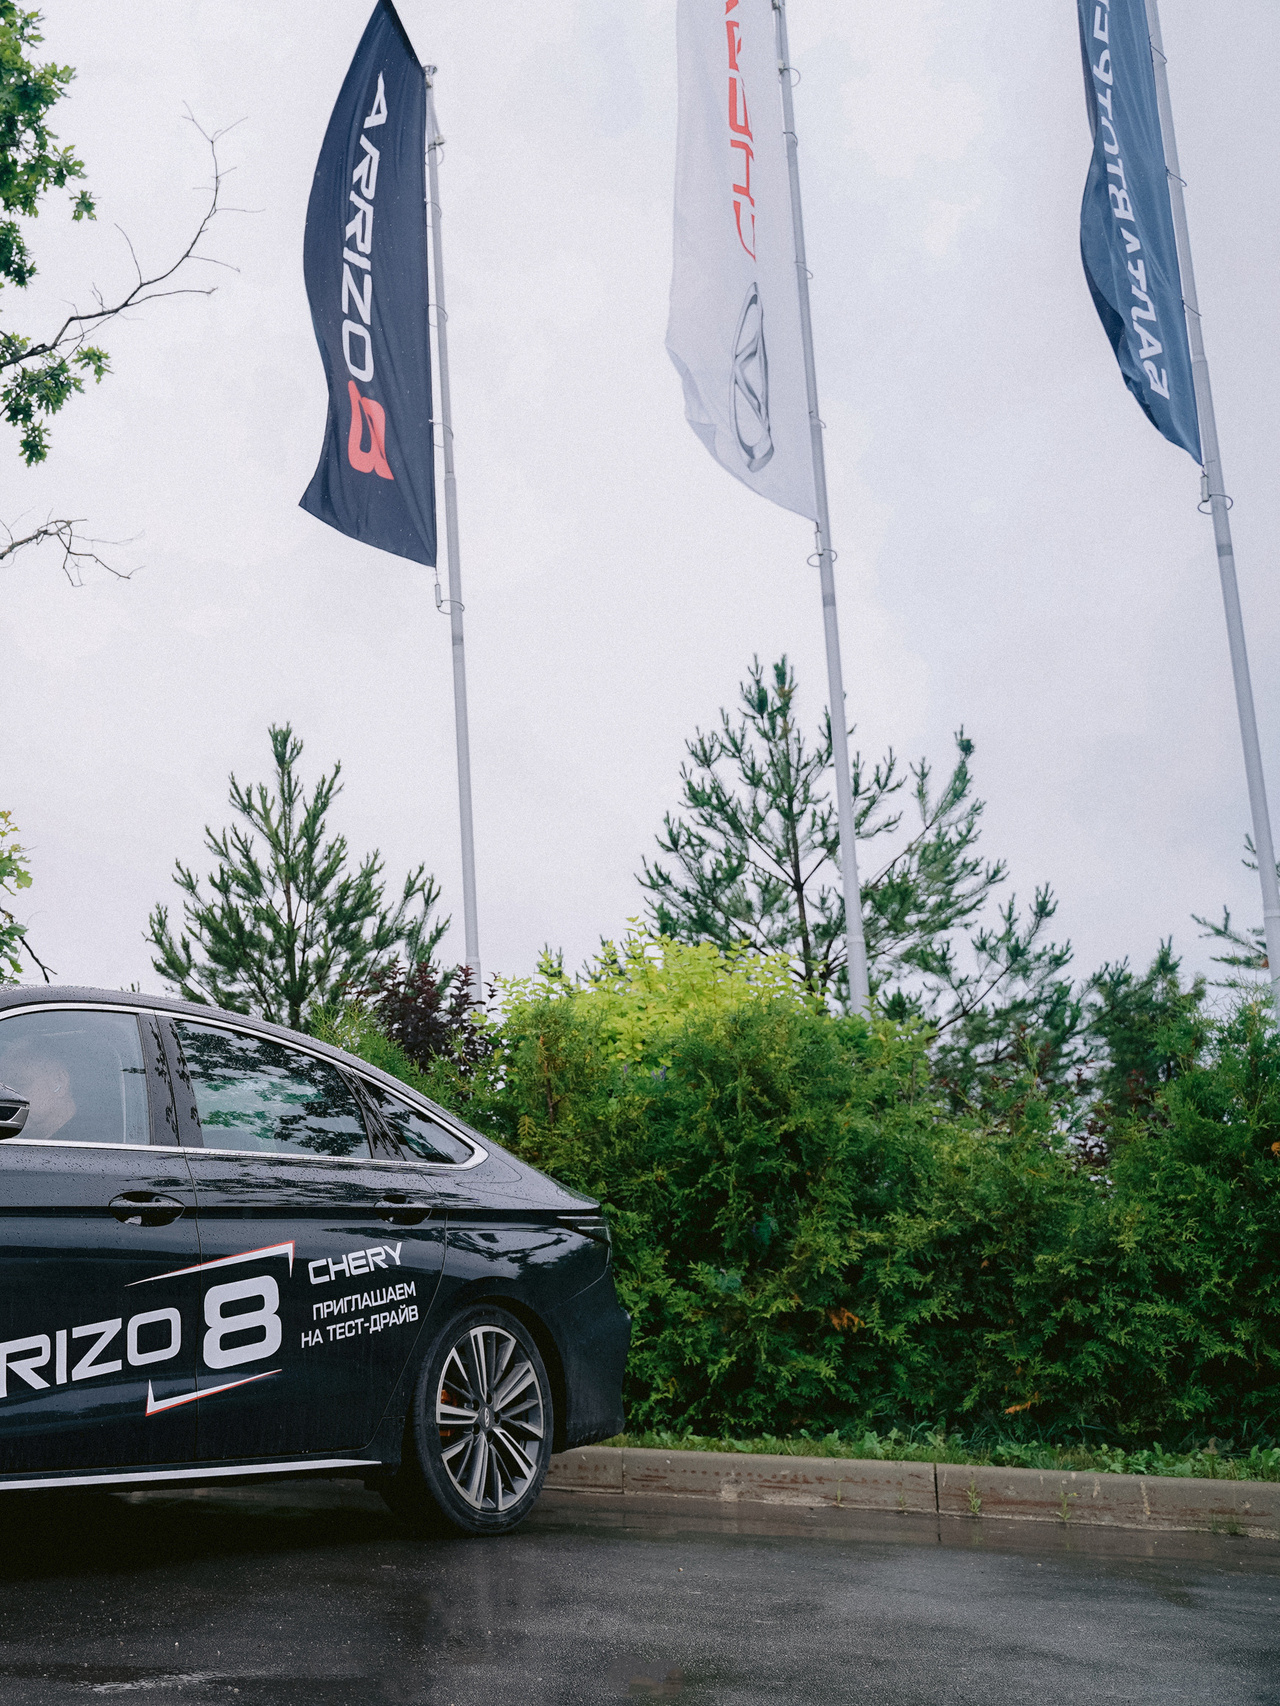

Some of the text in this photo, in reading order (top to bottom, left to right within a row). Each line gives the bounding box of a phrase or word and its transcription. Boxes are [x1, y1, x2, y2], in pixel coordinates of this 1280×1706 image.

[341, 70, 389, 383] ARRIZO
[308, 1241, 403, 1285] CHERY
[202, 1274, 283, 1370] 8
[312, 1280, 417, 1321] ПРИГЛАШАЕМ
[301, 1303, 419, 1349] НА ТЕСТ-ДРАЙВ
